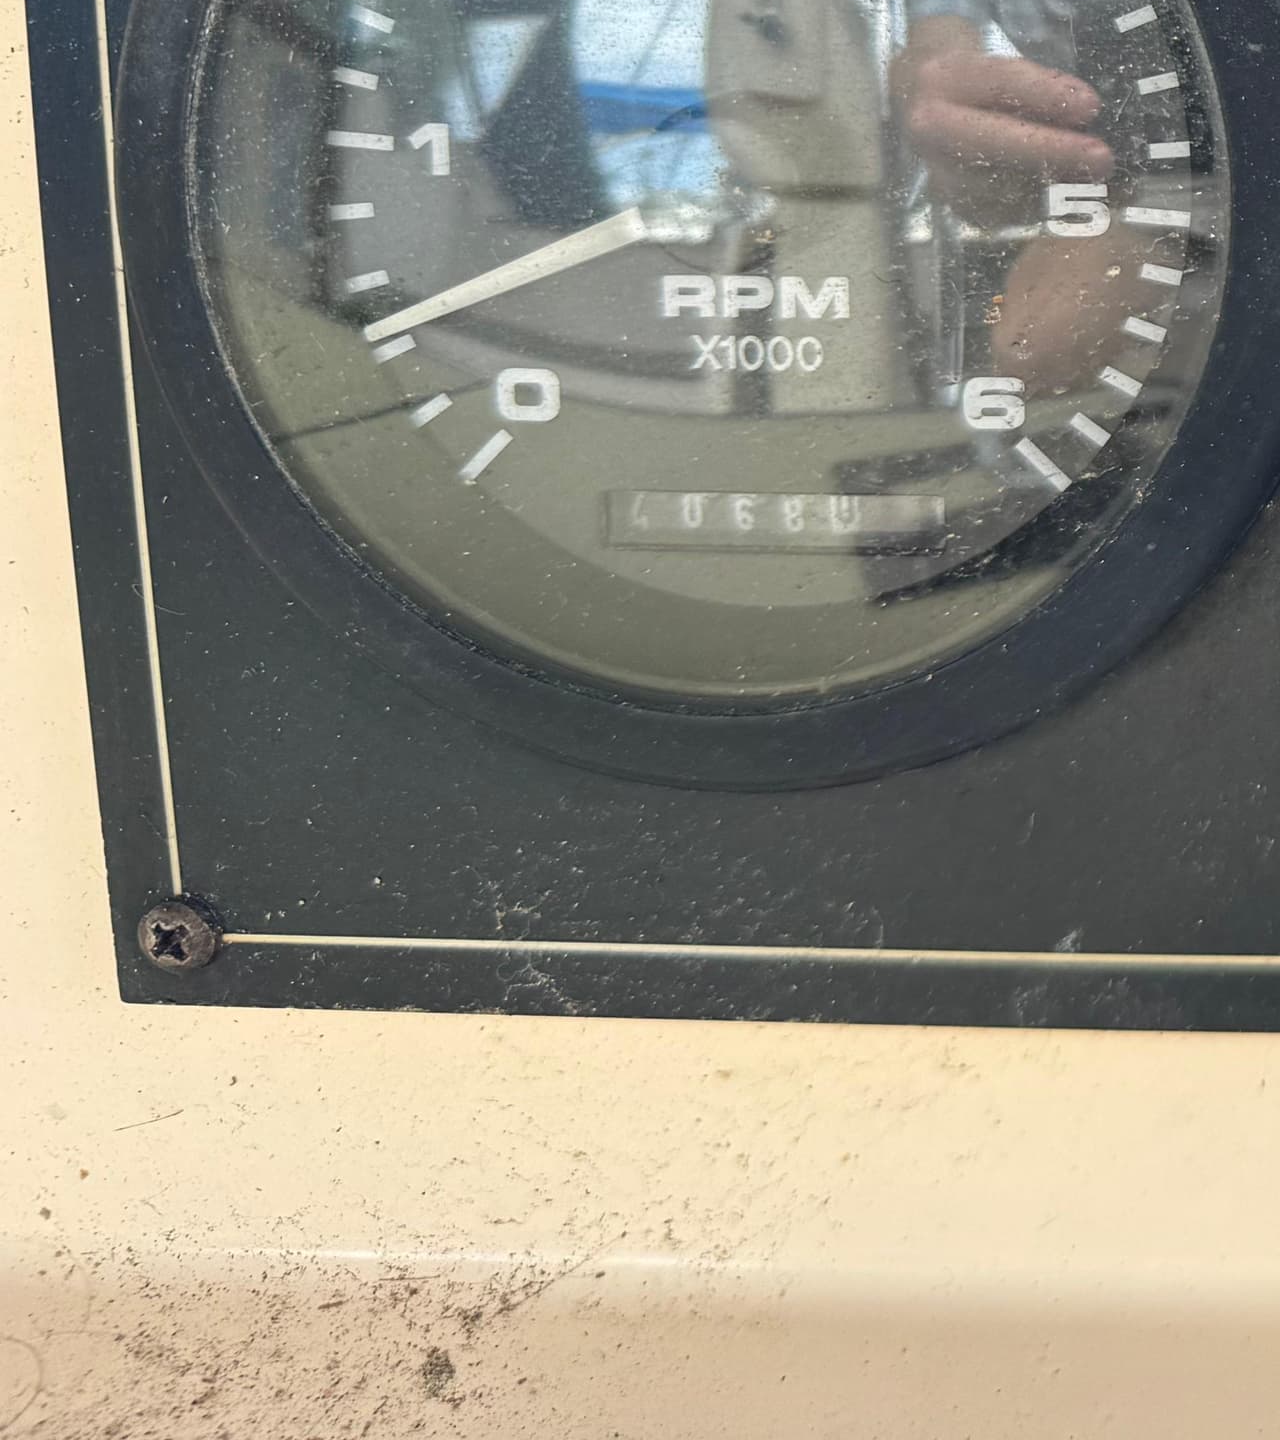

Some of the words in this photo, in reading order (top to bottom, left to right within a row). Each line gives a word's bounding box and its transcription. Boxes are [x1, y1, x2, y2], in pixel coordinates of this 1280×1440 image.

[408, 123, 451, 176] 1
[1048, 183, 1111, 237] 5
[662, 274, 851, 319] RPM
[688, 334, 824, 372] X1000
[495, 366, 562, 422] 0
[961, 375, 1027, 430] 6
